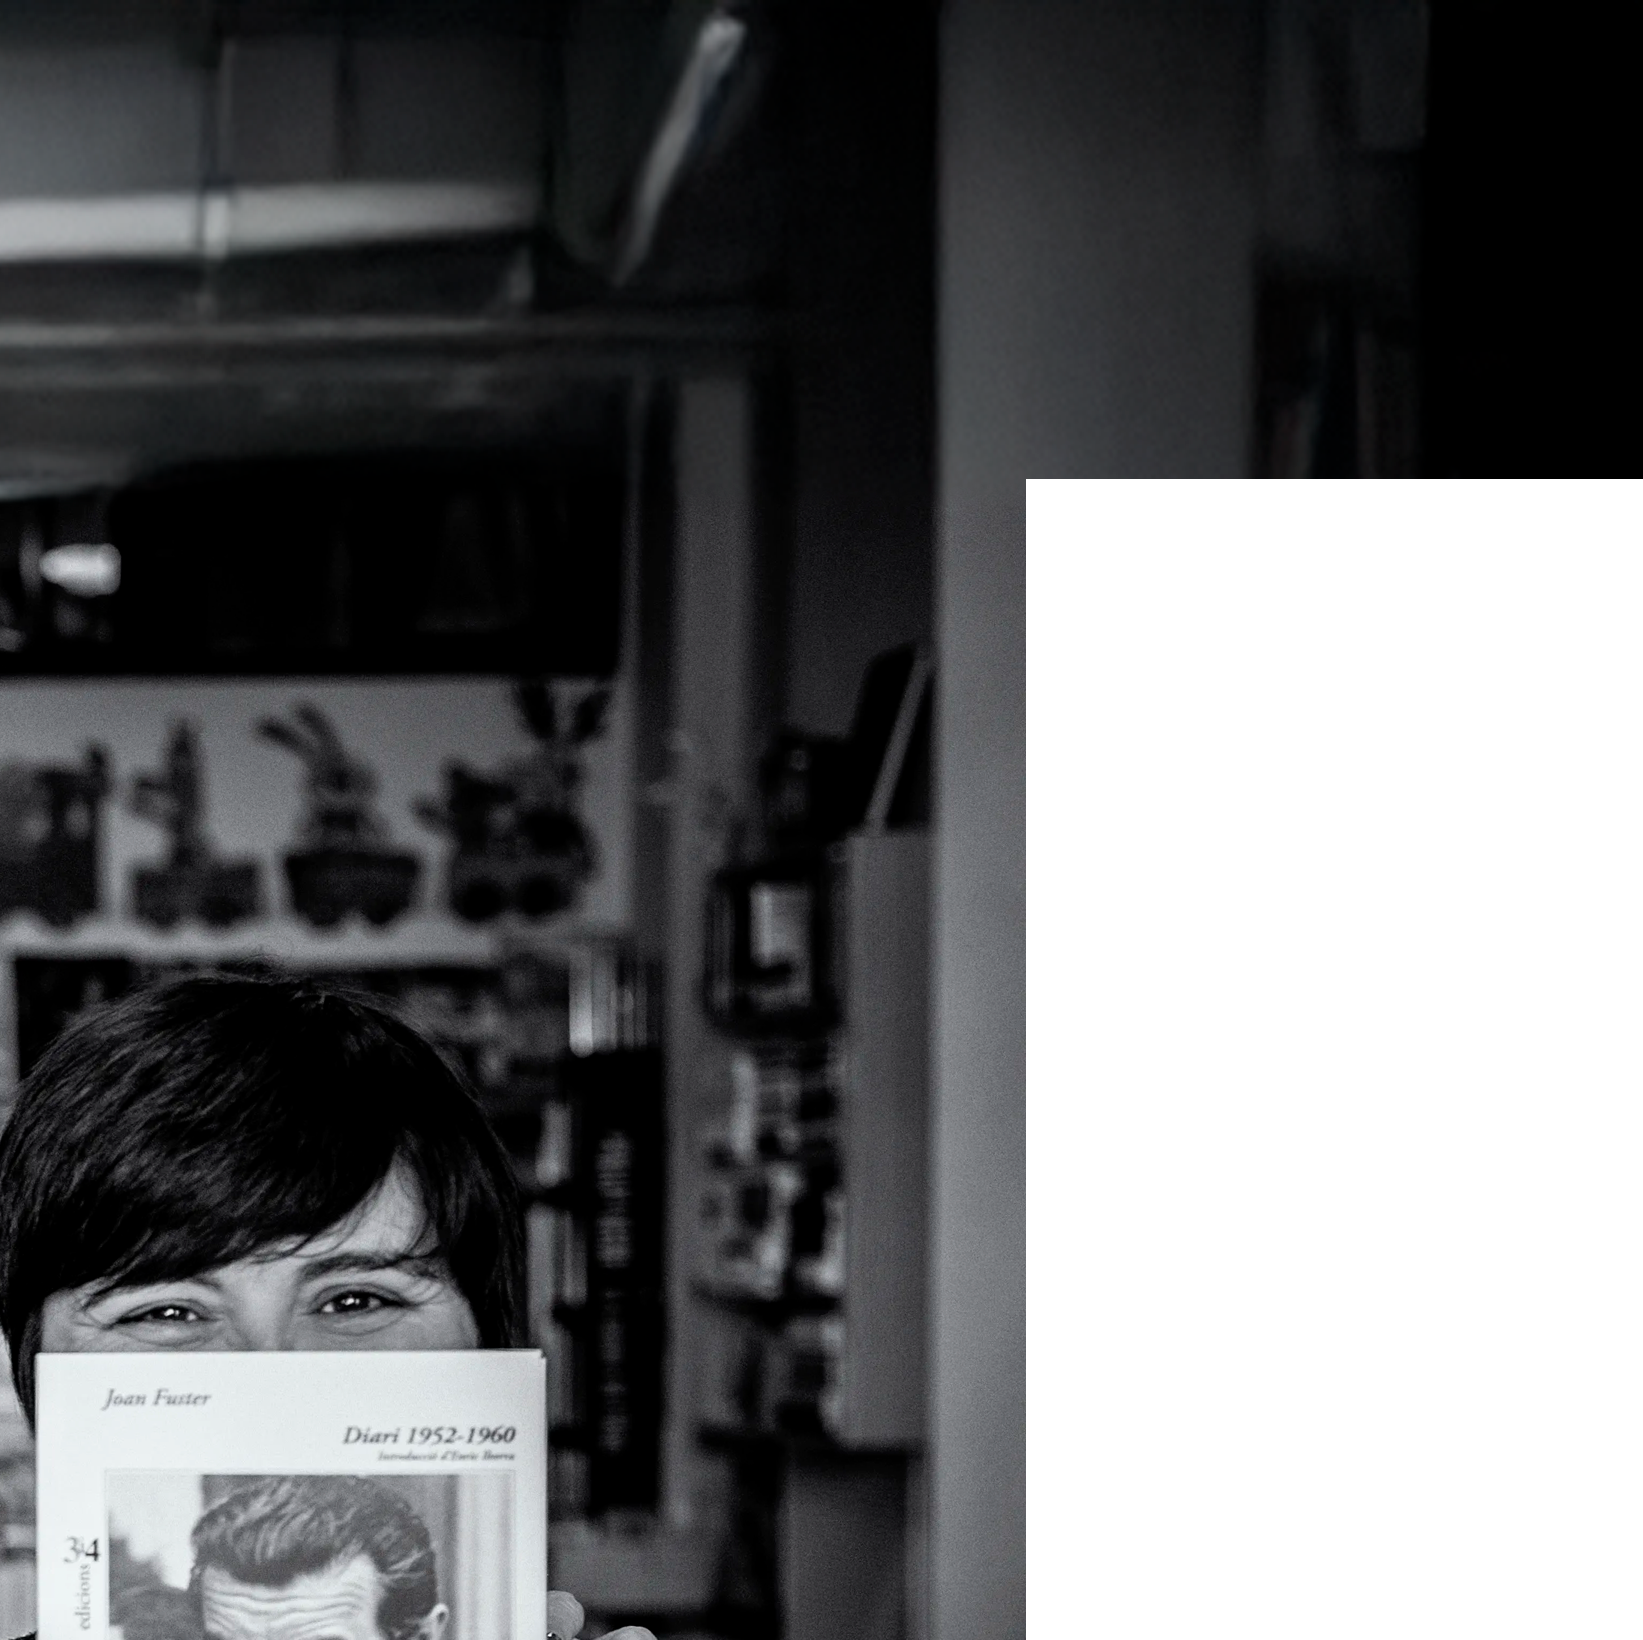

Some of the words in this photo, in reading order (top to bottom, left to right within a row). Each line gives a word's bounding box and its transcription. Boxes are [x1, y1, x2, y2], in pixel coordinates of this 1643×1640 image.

[100, 1388, 147, 1411] Joan
[153, 1387, 213, 1406] Fuster
[343, 1426, 401, 1445] Diari
[407, 1425, 516, 1446] 1952-1960
[74, 1564, 91, 1631] edicions
